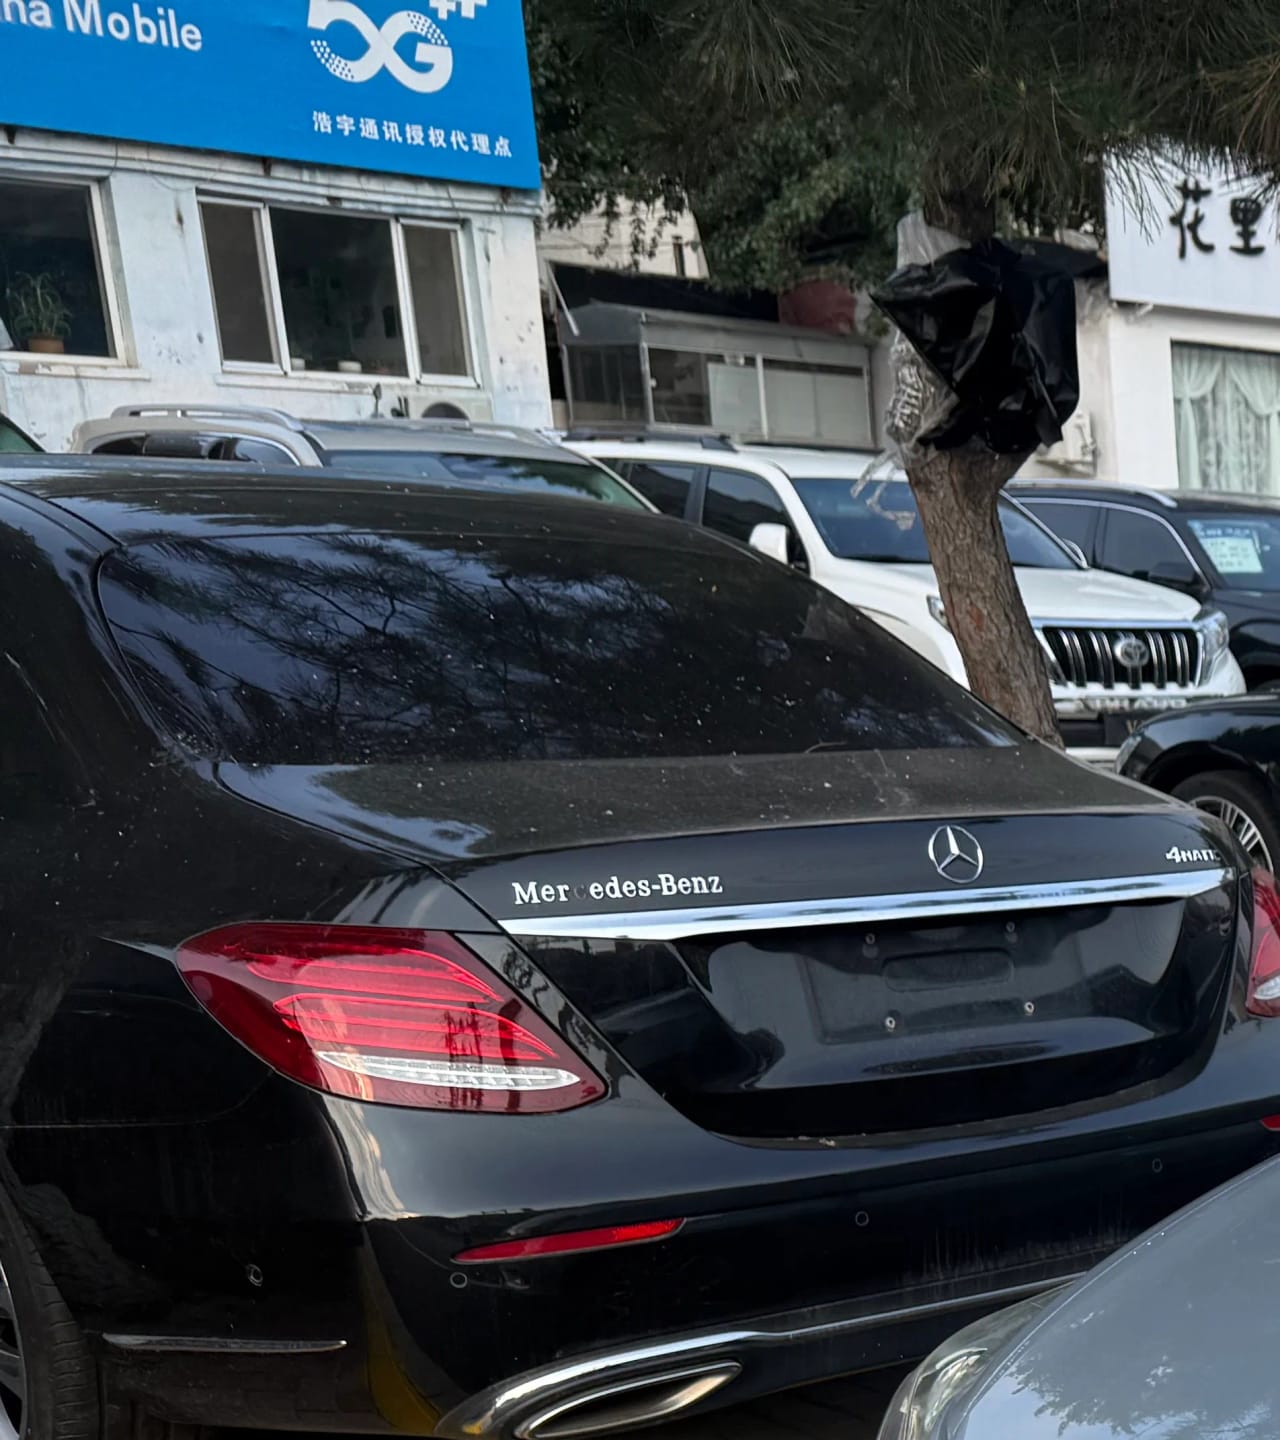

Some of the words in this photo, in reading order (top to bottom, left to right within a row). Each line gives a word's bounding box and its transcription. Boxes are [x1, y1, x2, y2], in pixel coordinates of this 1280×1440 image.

[0, 0, 53, 28] na
[62, 0, 203, 51] Mobile
[312, 110, 513, 158] 浩宇通讯授权代理点
